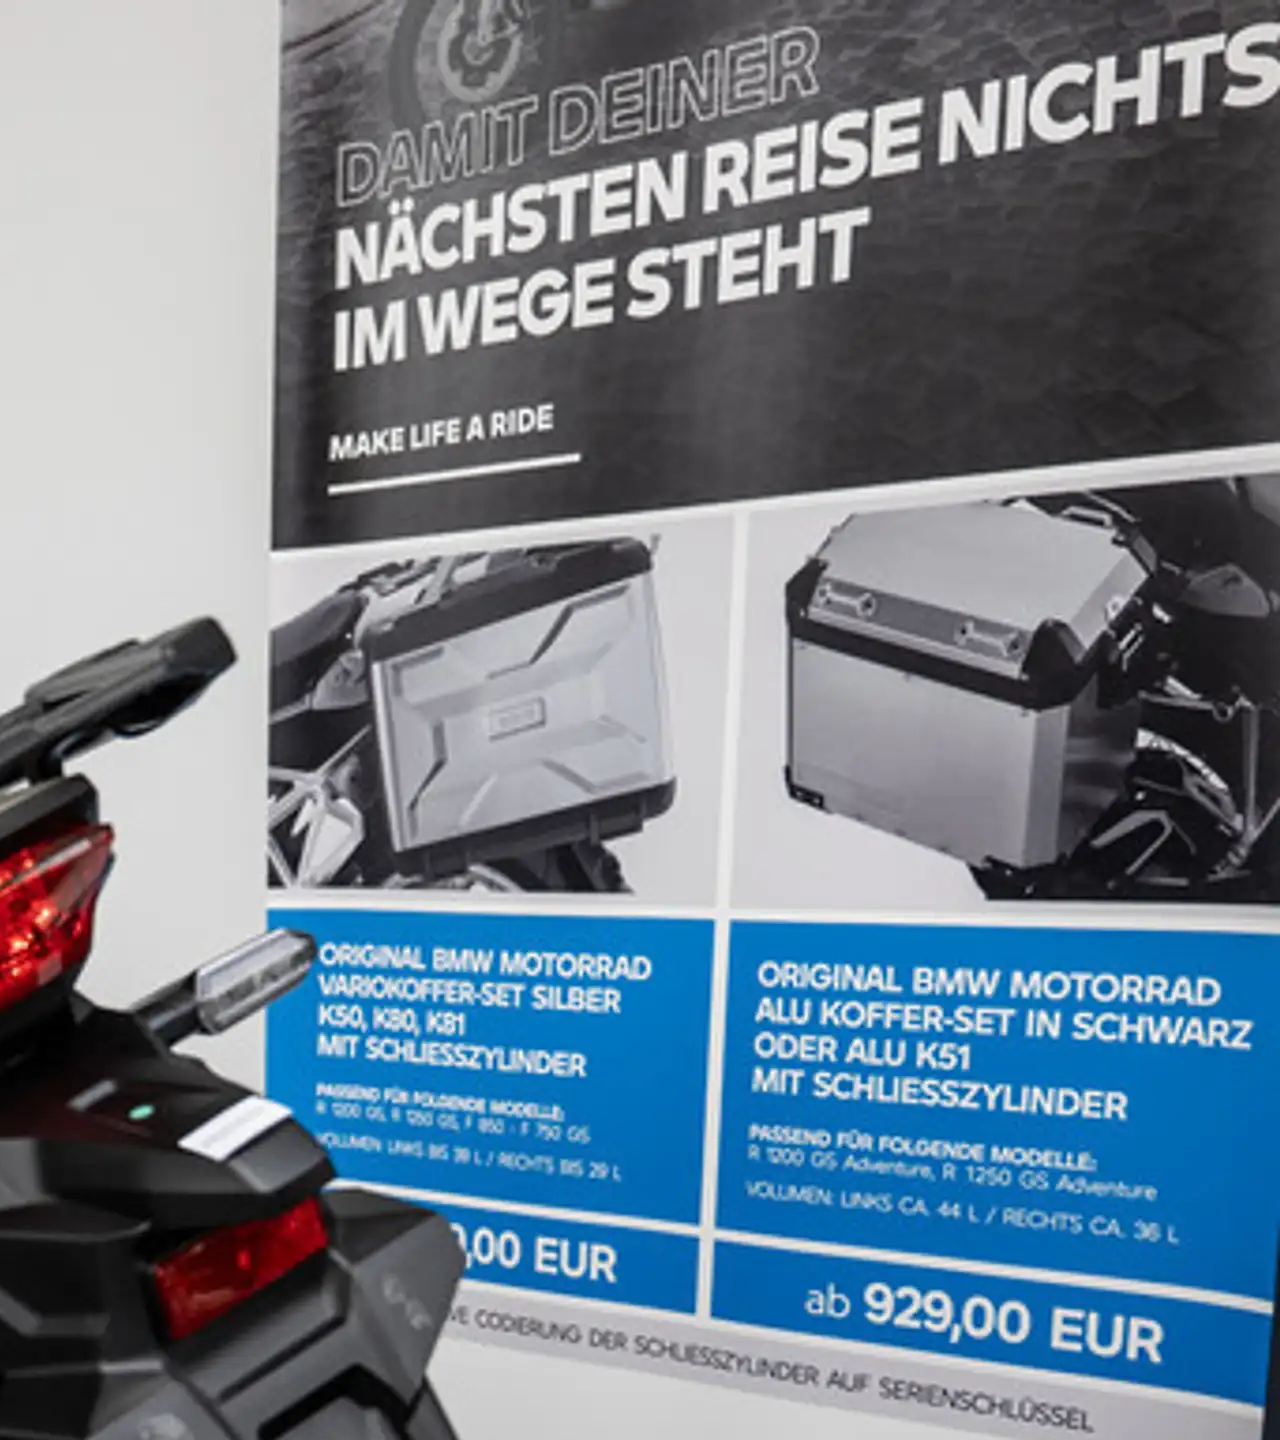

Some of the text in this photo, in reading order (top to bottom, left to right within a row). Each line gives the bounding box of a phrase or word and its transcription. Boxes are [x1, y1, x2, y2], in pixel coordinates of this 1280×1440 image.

[337, 25, 820, 208] DAMIT DEINER
[335, 22, 1280, 290] NÄCHSTEN REISE NICHTS
[334, 207, 872, 370] IM WEGE STEHT
[328, 402, 554, 462] MAKE LIFE A RIDE
[319, 943, 652, 981] ORIGINAL BMW MOTORRAD
[757, 961, 1221, 1007] ORIGINAL BMW MOTORRAD
[318, 974, 621, 1014] VARIOKOFFER-SET SILBER
[755, 998, 1254, 1050] ALU KOFFER-SET IN SCHWARZ
[317, 1036, 587, 1078] MIT SCHLIESSZYLINDER
[754, 1033, 971, 1071] ODER ALU K51
[751, 1068, 1128, 1121] MIT SCHLIESSZYLINDER
[748, 1125, 1097, 1172] PASSEND FÜR FOLGENDE MODELLE:
[748, 1145, 760, 1161] R
[810, 1151, 838, 1170] GS
[943, 1163, 957, 1182] R
[966, 1165, 1011, 1187] 1250
[1021, 1169, 1049, 1191] GS
[1056, 1172, 1158, 1202] Adventure
[840, 1187, 892, 1213] LINKS
[968, 1204, 980, 1224] L
[1002, 1206, 1083, 1235] RECHTS
[1166, 1224, 1180, 1245] L
[534, 1235, 618, 1285] EUR
[805, 1283, 1165, 1364] ab 929,00 EUR
[589, 1327, 628, 1351] DER
[634, 1334, 819, 1387] SCHLIESSZYLINDER
[826, 1370, 871, 1394] AUF
[878, 1376, 1095, 1434] SERIENSCHLÜSSEL
